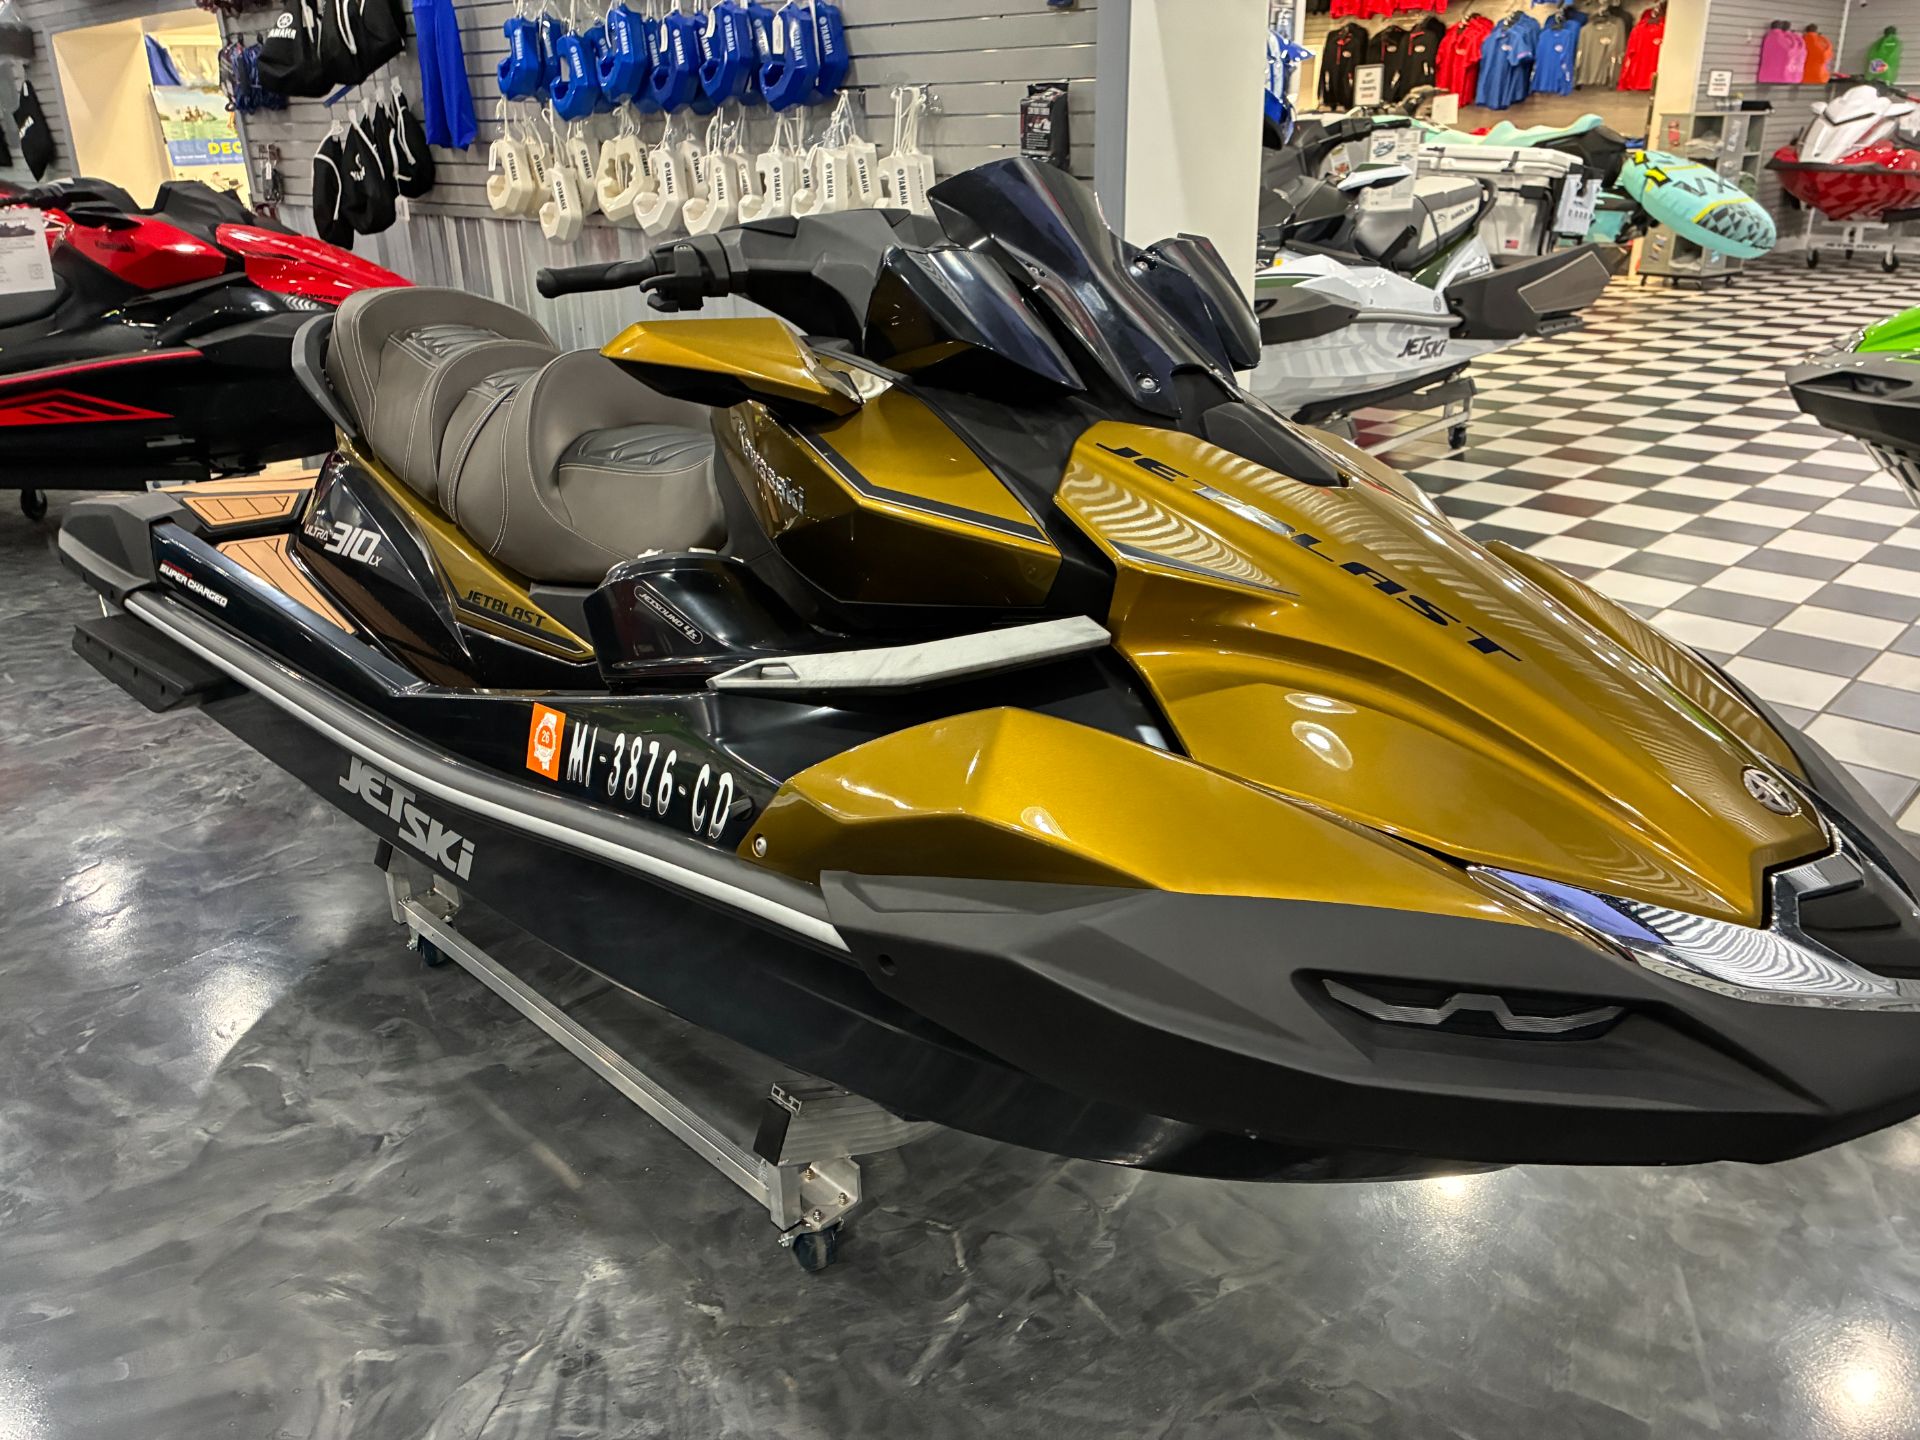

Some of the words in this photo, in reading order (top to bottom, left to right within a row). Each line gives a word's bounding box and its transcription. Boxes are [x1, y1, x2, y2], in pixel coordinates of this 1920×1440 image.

[619, 27, 630, 55] YAMAHA
[673, 36, 685, 65] YAMAHA
[724, 23, 736, 52] YAMAHA
[820, 24, 834, 55] YAMAHA
[571, 53, 584, 78] YAMAHA
[649, 40, 660, 67] YAMAHA
[508, 158, 519, 182] YAMAHA
[581, 155, 592, 179] YAMAHA
[641, 153, 651, 176] YAMAHA
[692, 158, 703, 184] YAMAHA
[664, 167, 674, 194] YAMAHA
[716, 175, 724, 200] YAMAHA
[774, 175, 782, 201] YAMAHA
[826, 171, 834, 199] YAMAHA
[858, 164, 870, 194] YAMAHA
[898, 176, 908, 205] YAMAHA
[556, 186, 566, 210] YAMAHA
[304, 523, 329, 541] ULTRA
[324, 521, 382, 563] 310
[368, 554, 383, 567] LX
[159, 563, 188, 586] SUPER
[187, 579, 228, 608] CHARGED
[465, 589, 547, 627] JETBLAST
[639, 592, 684, 630] JETSOUND
[541, 729, 551, 744] 26
